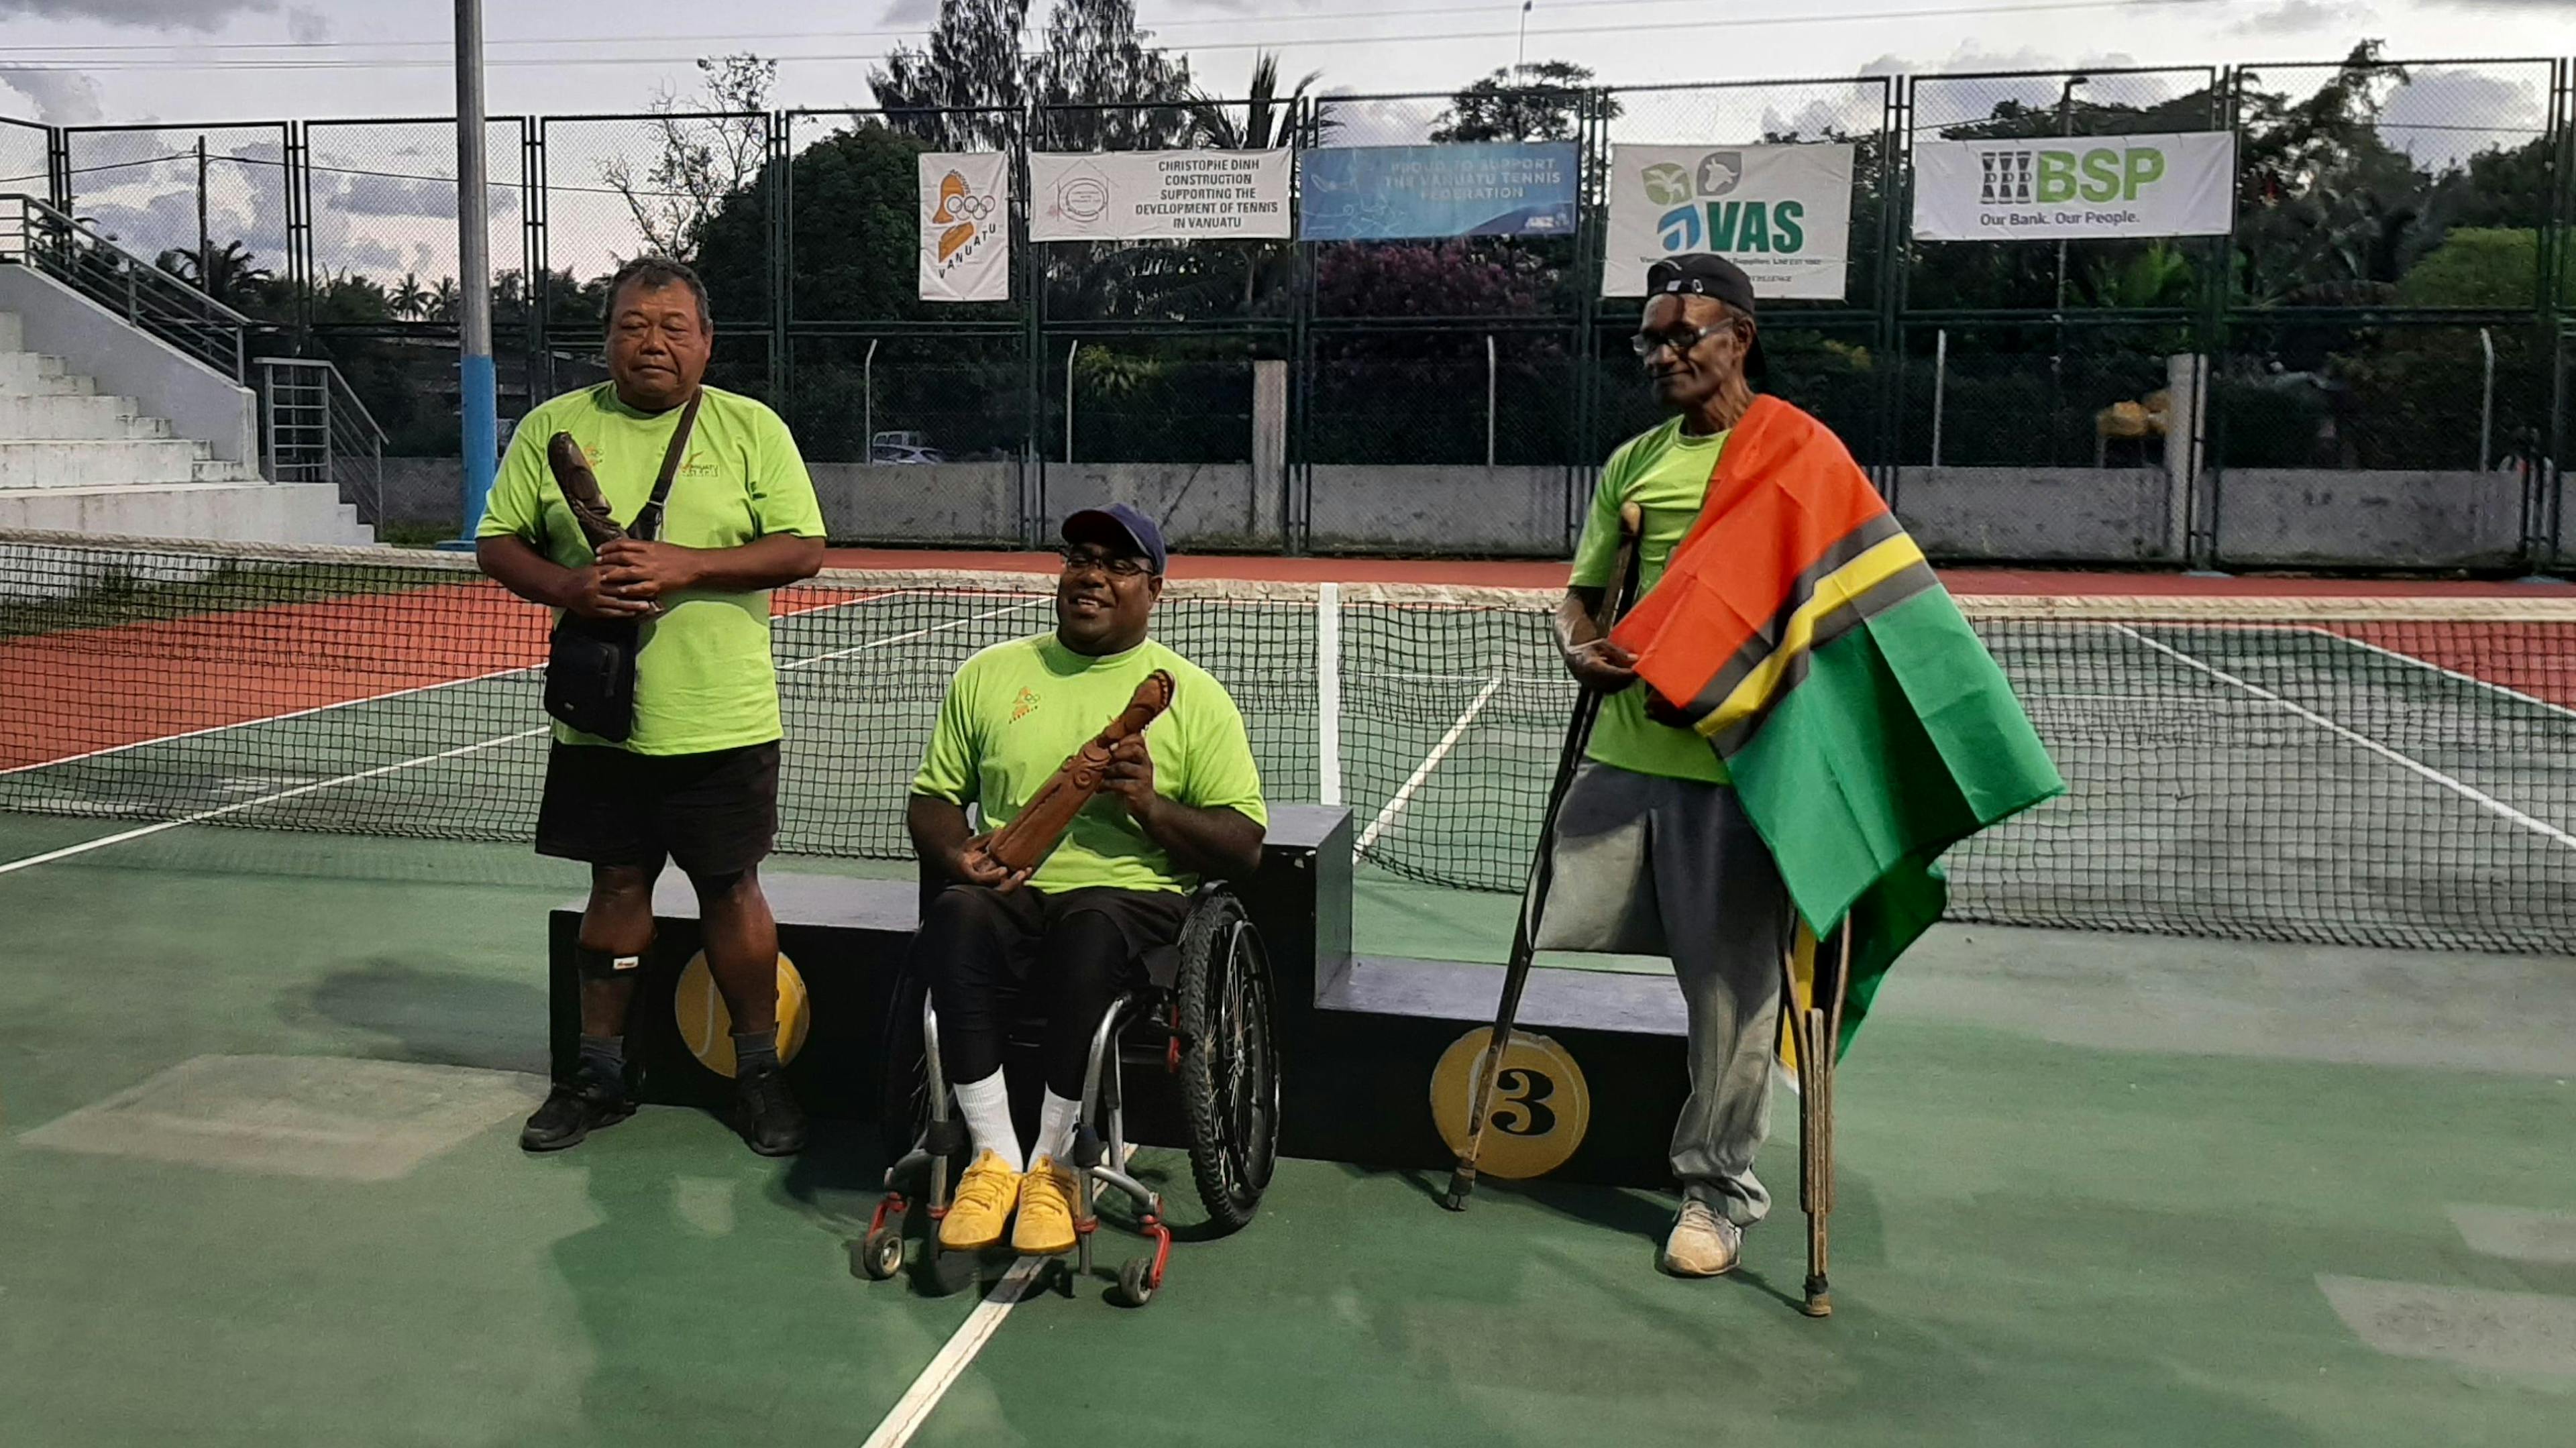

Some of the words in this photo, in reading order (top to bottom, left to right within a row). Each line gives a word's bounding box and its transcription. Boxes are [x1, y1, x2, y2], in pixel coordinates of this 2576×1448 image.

[1159, 160, 1228, 172] CHRISTOPHE
[1231, 159, 1259, 170] DINH
[1391, 160, 1445, 174] PROUD
[1454, 160, 1474, 172] TO
[1480, 158, 1556, 172] SUPPORT
[1165, 174, 1252, 186] CONSTRUCTION
[1384, 175, 1414, 188] THE
[1419, 173, 1497, 187] VANUATU
[1501, 172, 1561, 184] TENNIS
[2037, 147, 2165, 203] BSP
[1161, 188, 1232, 200] SUPPORTING
[1235, 188, 1256, 199] THE
[1421, 187, 1524, 200] FEDERATION
[1136, 203, 1217, 215] DEVELOPMENT
[1220, 203, 1234, 213] OF
[1236, 201, 1278, 213] TENNIS
[1174, 217, 1185, 228] IN
[1188, 217, 1242, 228] VANUATU
[1980, 213, 2006, 226] Our
[2010, 212, 2051, 225] Bank.
[2055, 211, 2082, 225] Our
[2085, 210, 2140, 226] People.
[1706, 201, 1805, 254] VAS
[938, 223, 996, 279] VANUATU
[1491, 1068, 1556, 1136] 3
